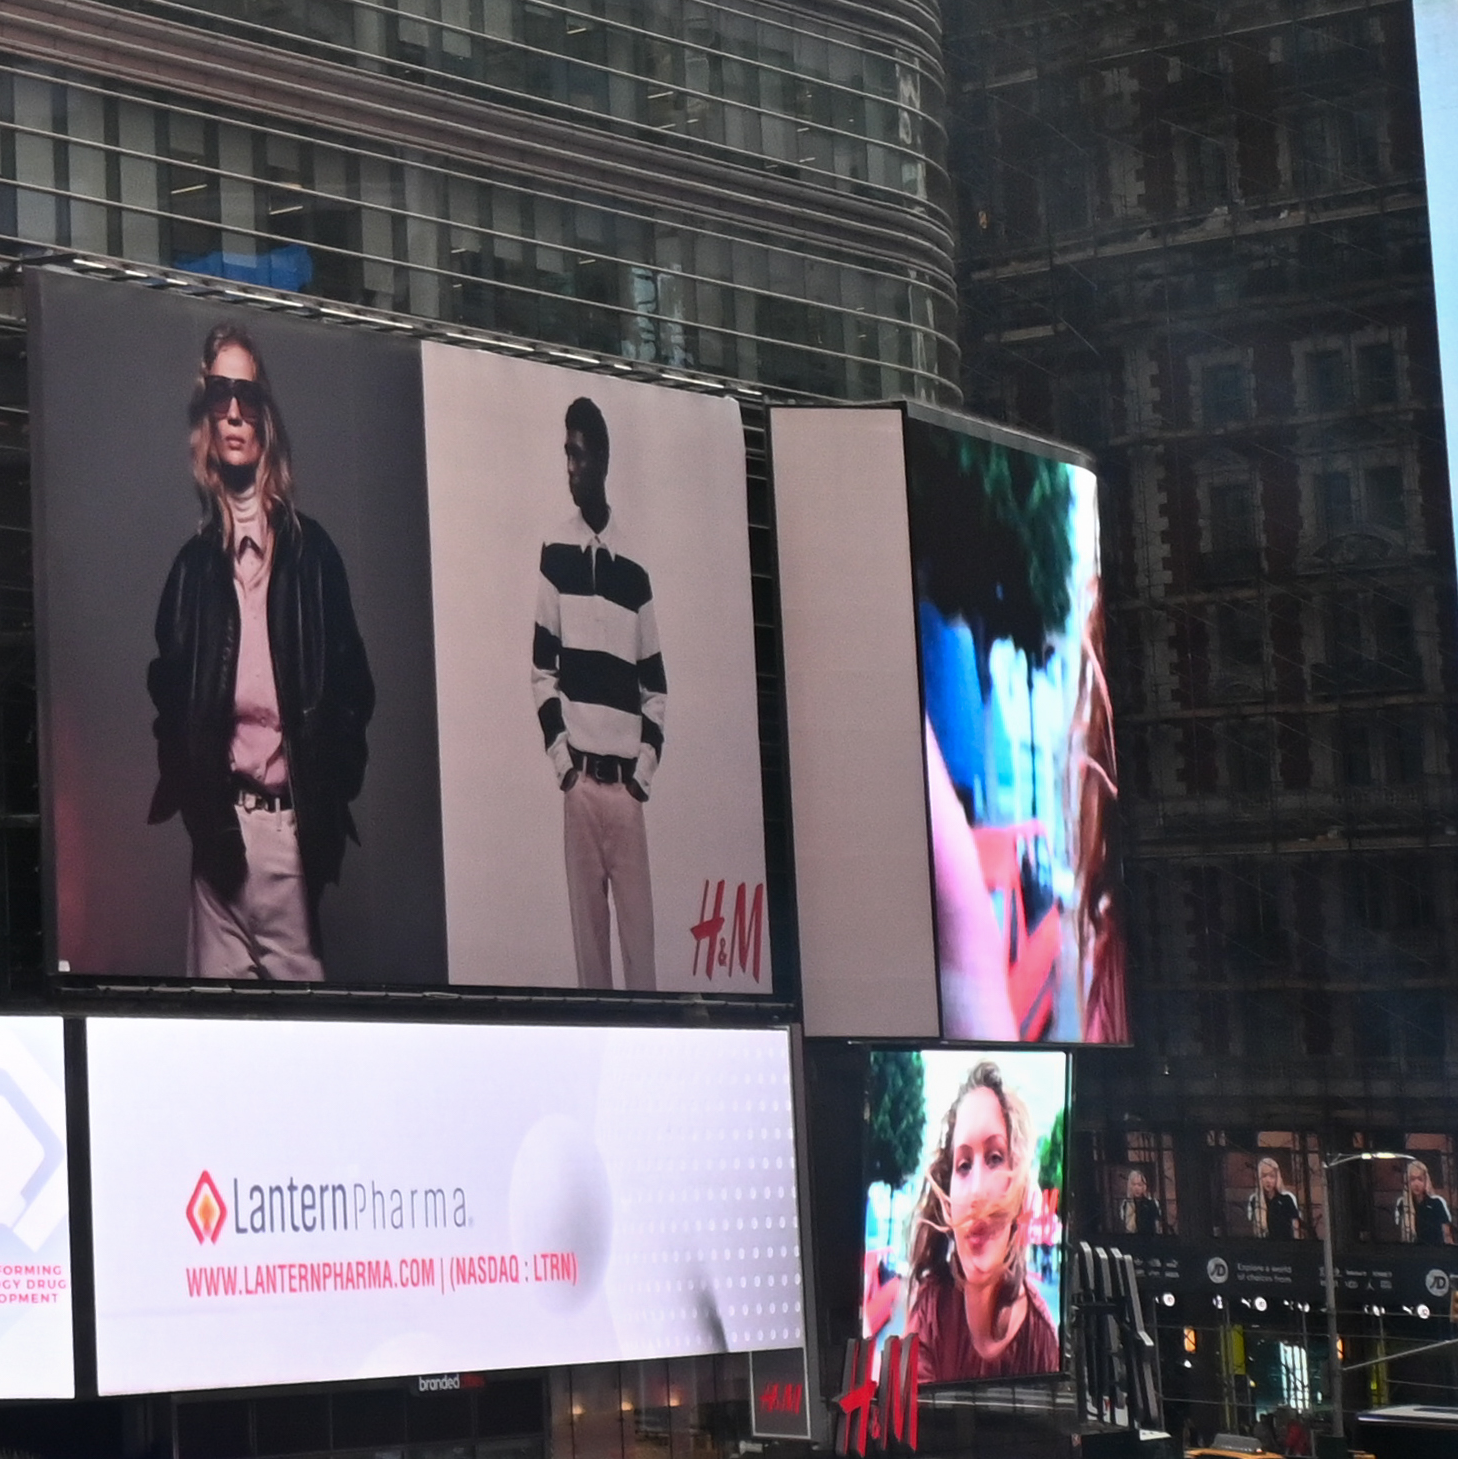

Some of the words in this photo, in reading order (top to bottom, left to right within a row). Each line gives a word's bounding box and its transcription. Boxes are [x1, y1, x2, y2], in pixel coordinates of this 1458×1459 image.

[690, 878, 764, 984] H&M
[26, 1279, 66, 1290] DRUG
[185, 1258, 435, 1298] WWW.LANTERNPHARMA.COM
[449, 1254, 519, 1292] (NASDAQ
[533, 1251, 578, 1286] LTRN)
[837, 1333, 919, 1457] H&M
